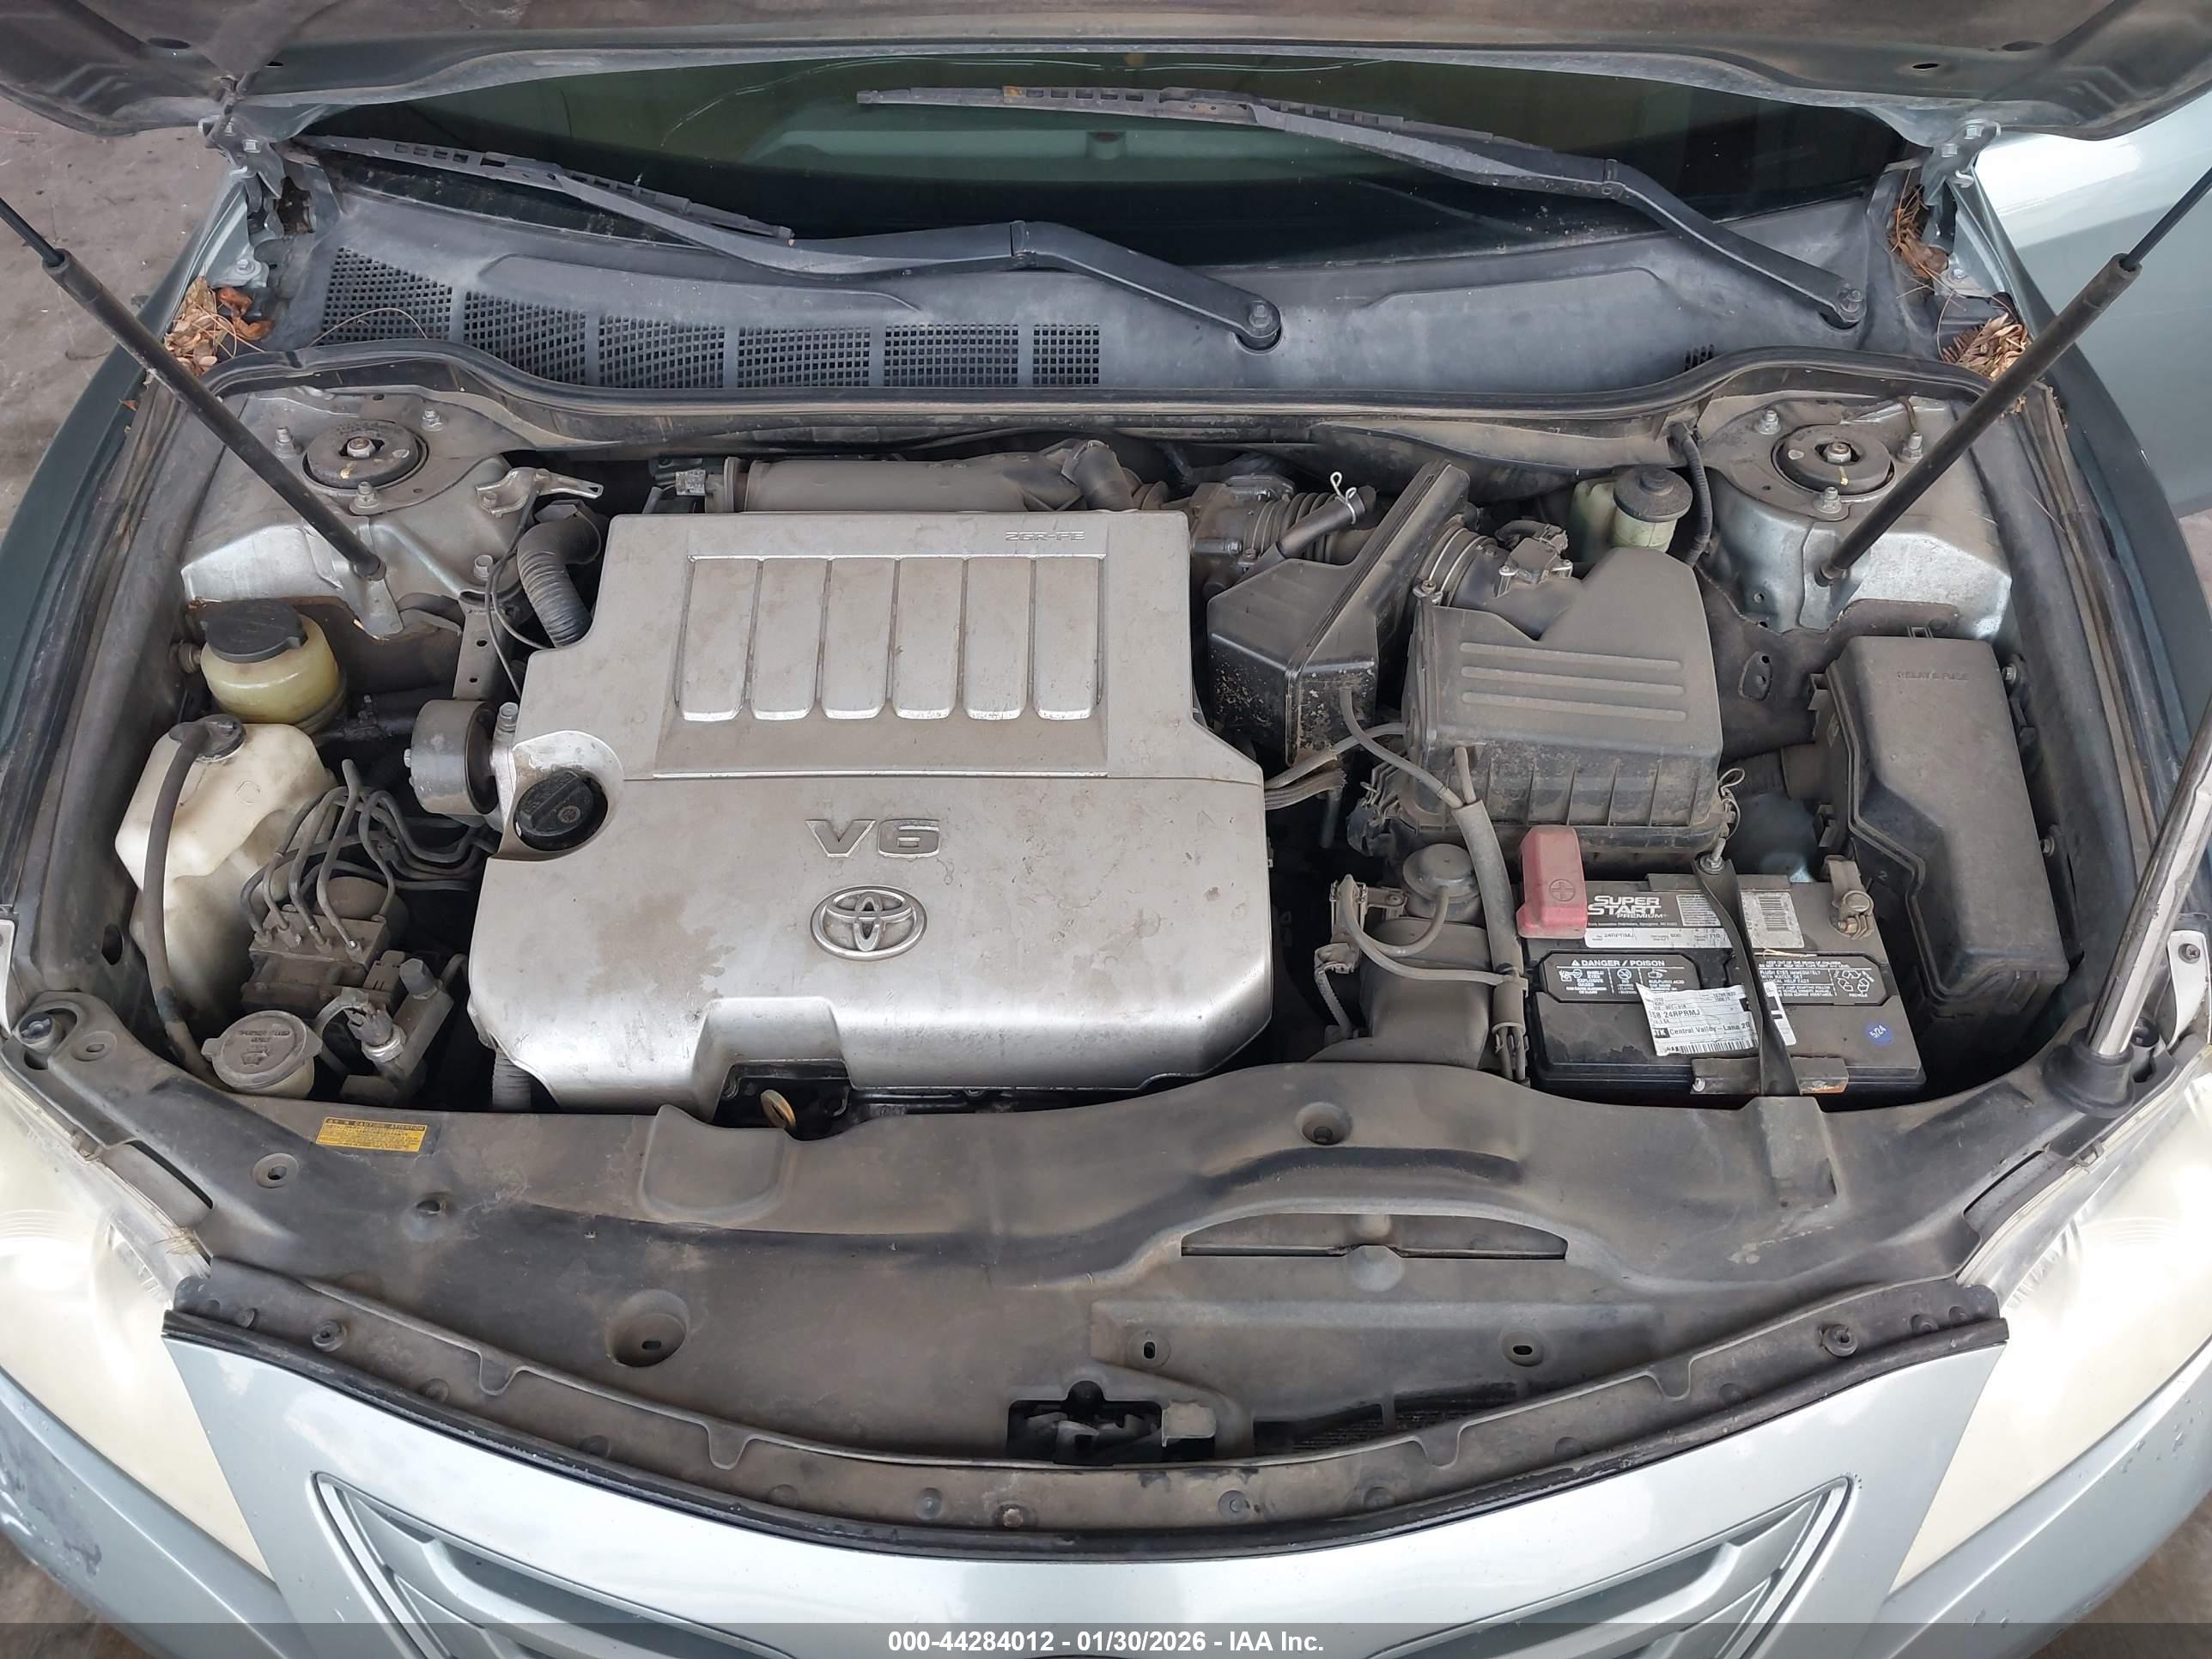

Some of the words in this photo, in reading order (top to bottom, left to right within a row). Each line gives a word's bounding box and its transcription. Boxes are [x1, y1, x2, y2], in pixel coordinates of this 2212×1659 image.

[1004, 531, 1085, 541] 2GR-FE
[805, 818, 941, 858] V6
[1593, 895, 1660, 905] SUPER
[1587, 904, 1662, 915] START
[1663, 1008, 1701, 1018] 24RPRMJ
[1669, 1027, 1694, 1036] Central
[1696, 1025, 1717, 1036] Valley
[1869, 1024, 1887, 1038] 5/24
